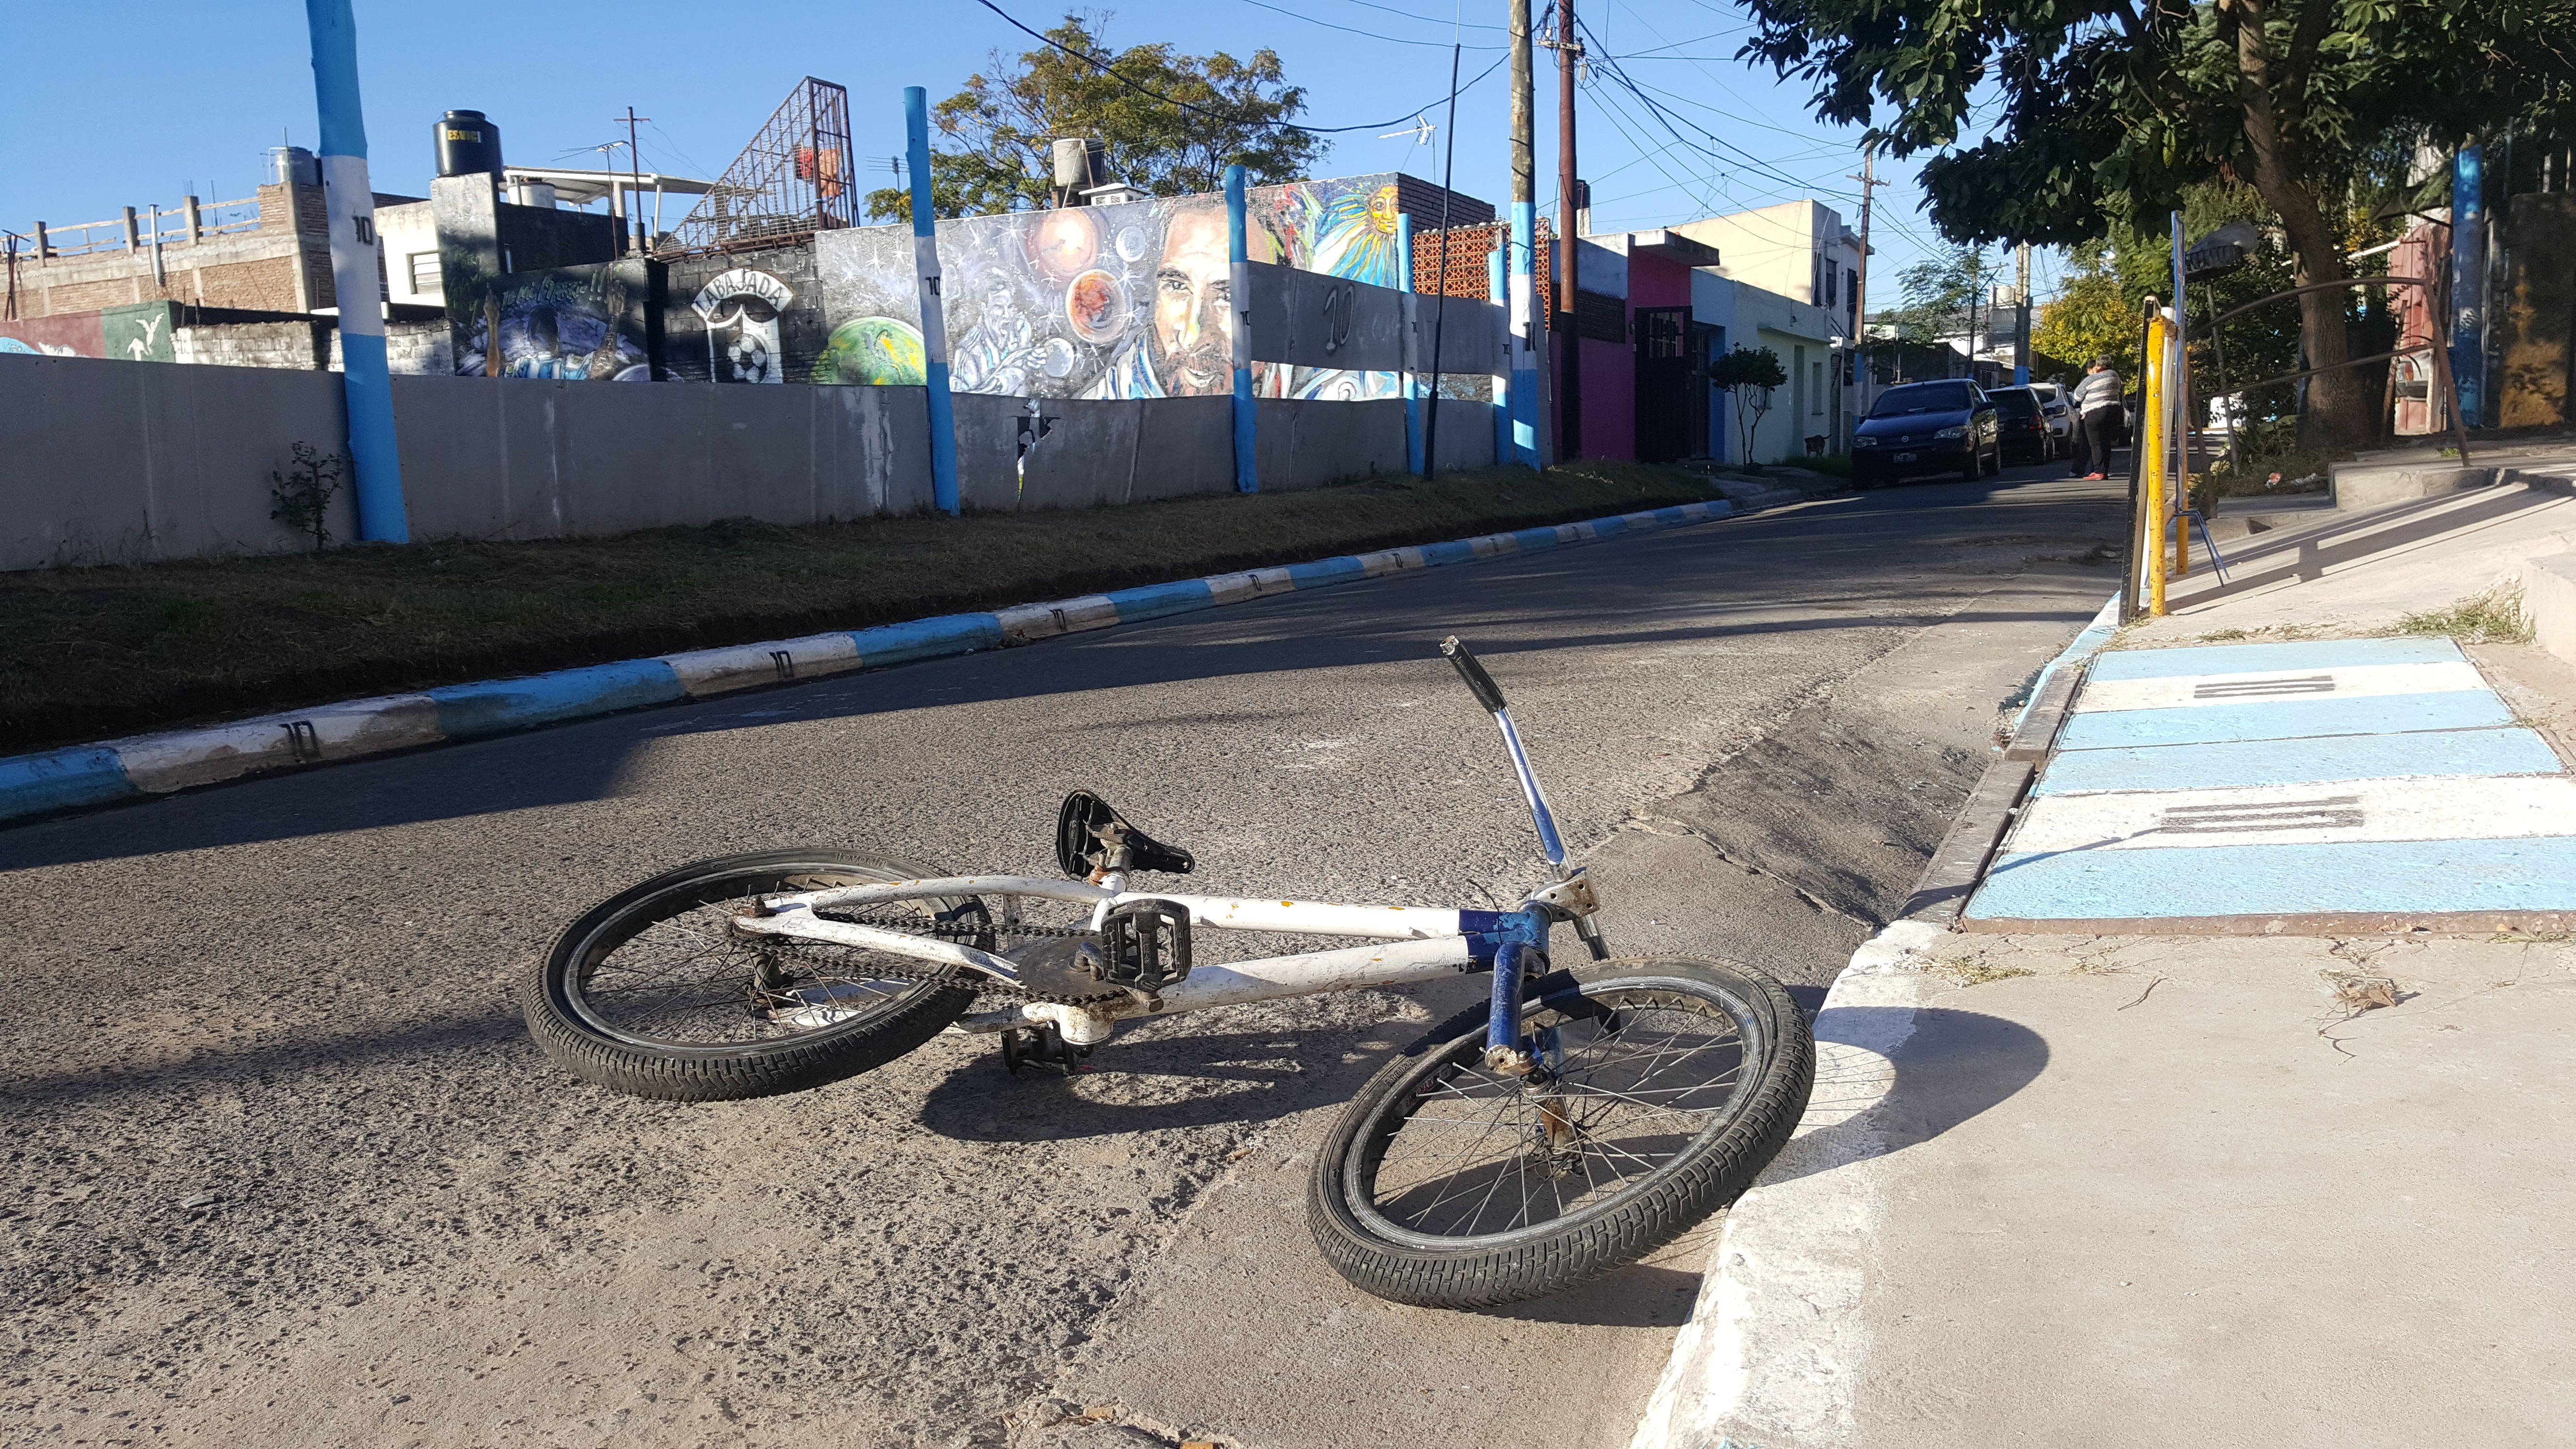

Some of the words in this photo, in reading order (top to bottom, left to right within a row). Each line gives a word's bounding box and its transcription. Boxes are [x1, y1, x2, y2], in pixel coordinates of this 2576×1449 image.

[352, 215, 373, 246] 10
[925, 276, 940, 296] 10
[1323, 283, 1355, 352] 10
[769, 650, 795, 678] 10
[278, 720, 322, 760] 10
